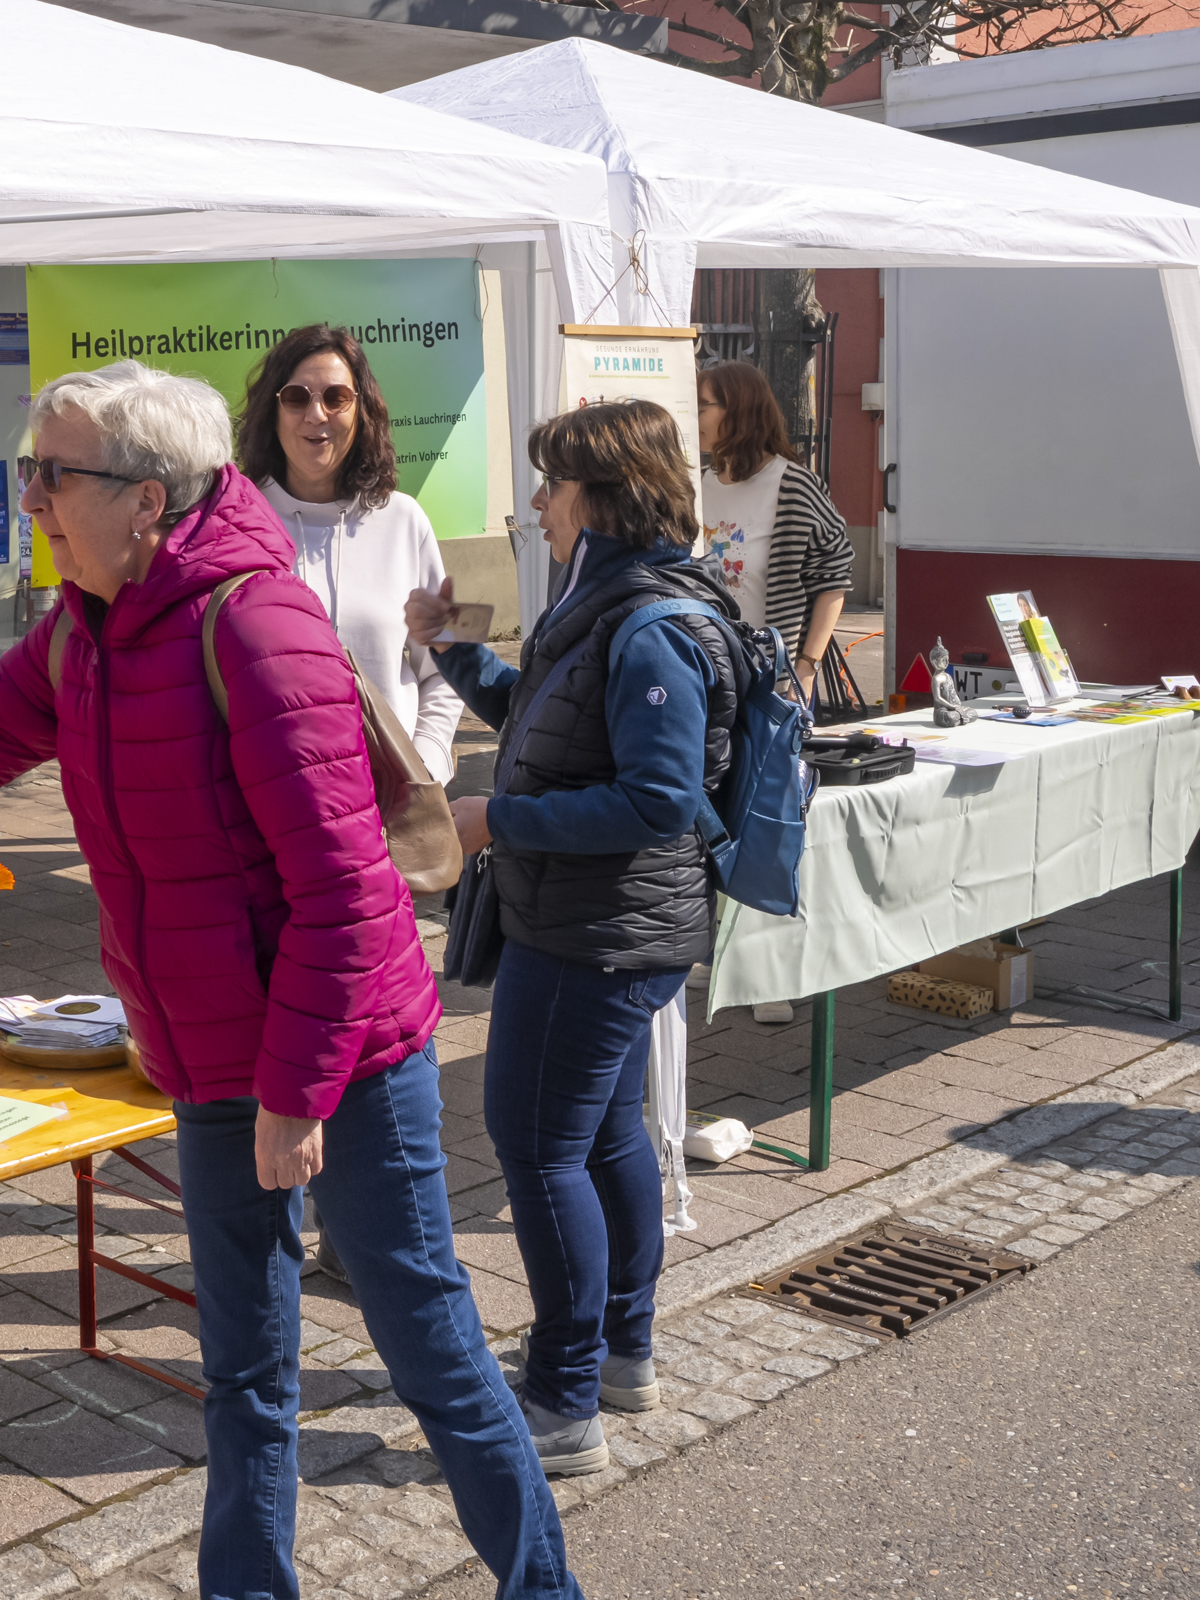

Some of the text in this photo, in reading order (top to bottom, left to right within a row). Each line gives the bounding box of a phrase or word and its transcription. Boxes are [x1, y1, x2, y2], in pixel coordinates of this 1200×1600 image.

[71, 322, 300, 359] Heilpraktikerinn
[595, 345, 623, 353] GESUNDE
[593, 356, 664, 372] PYRAMIDE
[413, 412, 467, 426] Lauchringen
[395, 449, 449, 464] atrin Vohrer
[955, 669, 983, 694] WT
